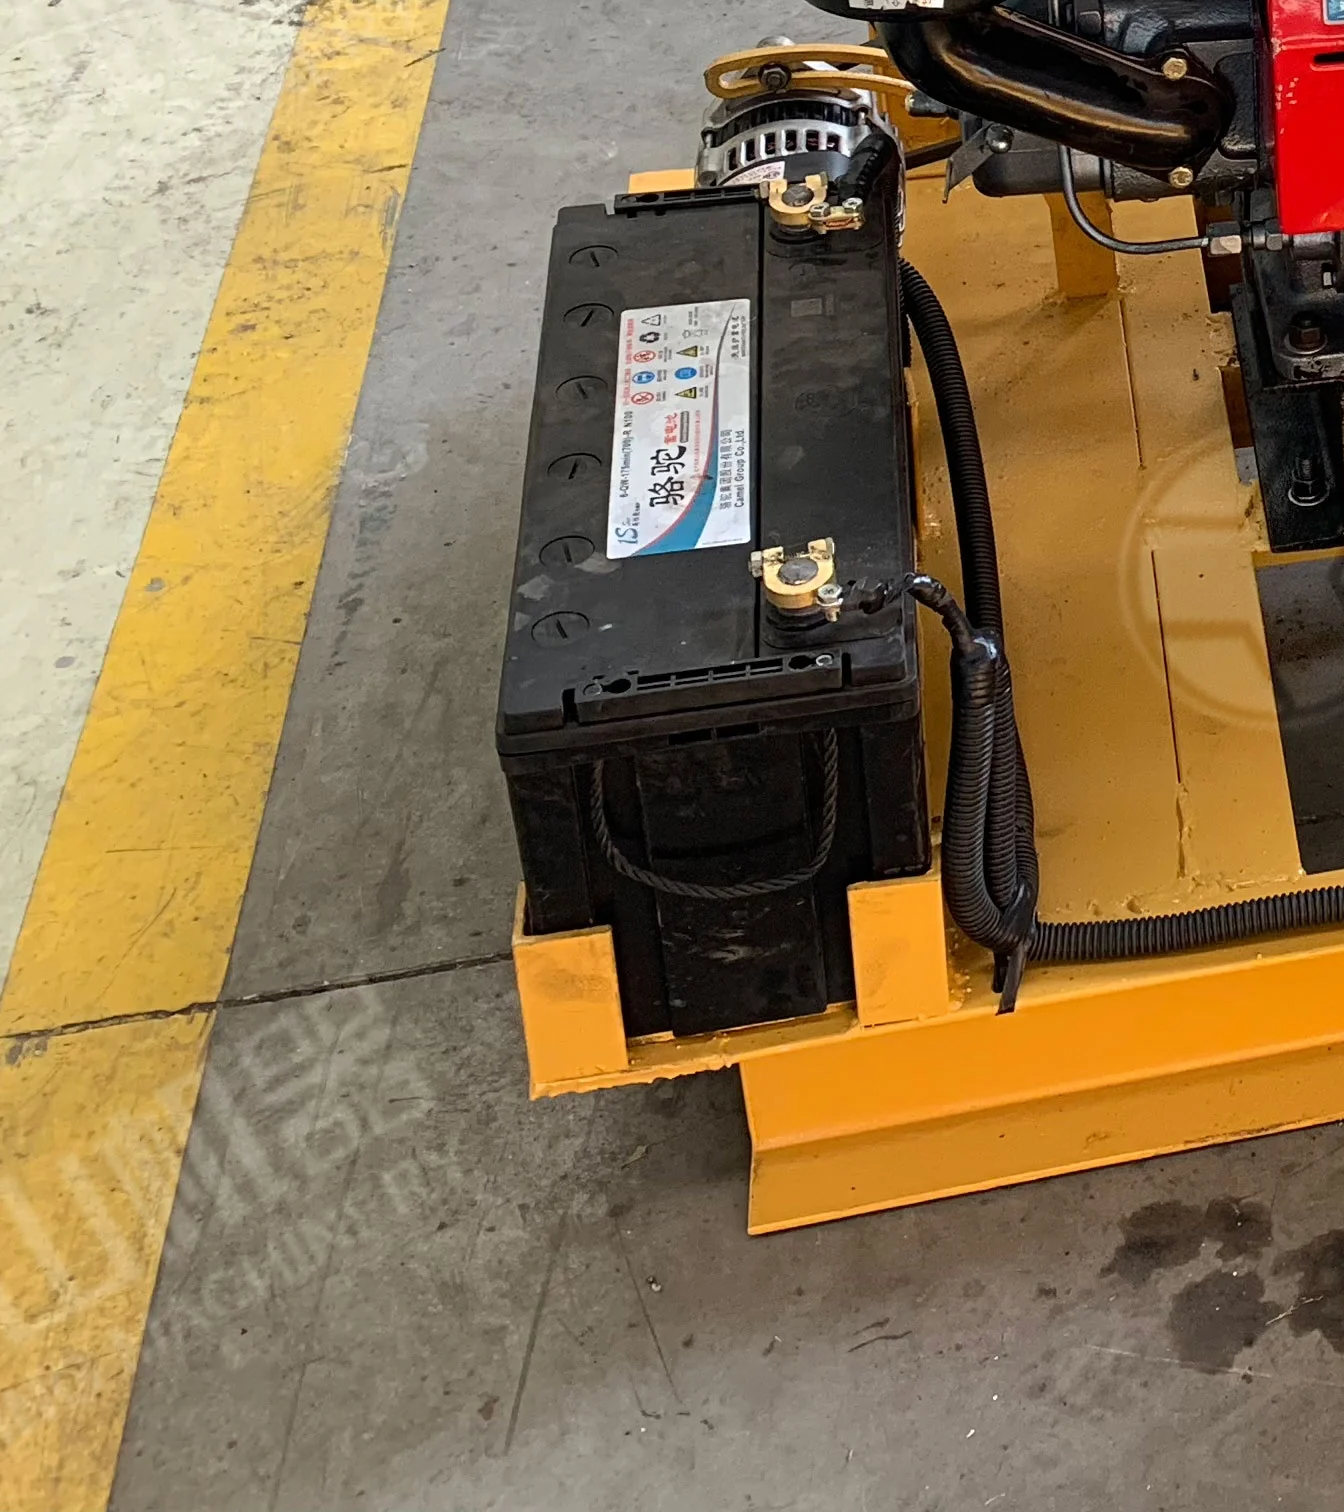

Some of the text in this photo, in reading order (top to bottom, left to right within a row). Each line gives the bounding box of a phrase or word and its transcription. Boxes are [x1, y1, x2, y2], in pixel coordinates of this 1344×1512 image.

[648, 445, 687, 508] 骆驼
[735, 458, 746, 482] Group
[734, 484, 745, 508] Camel
